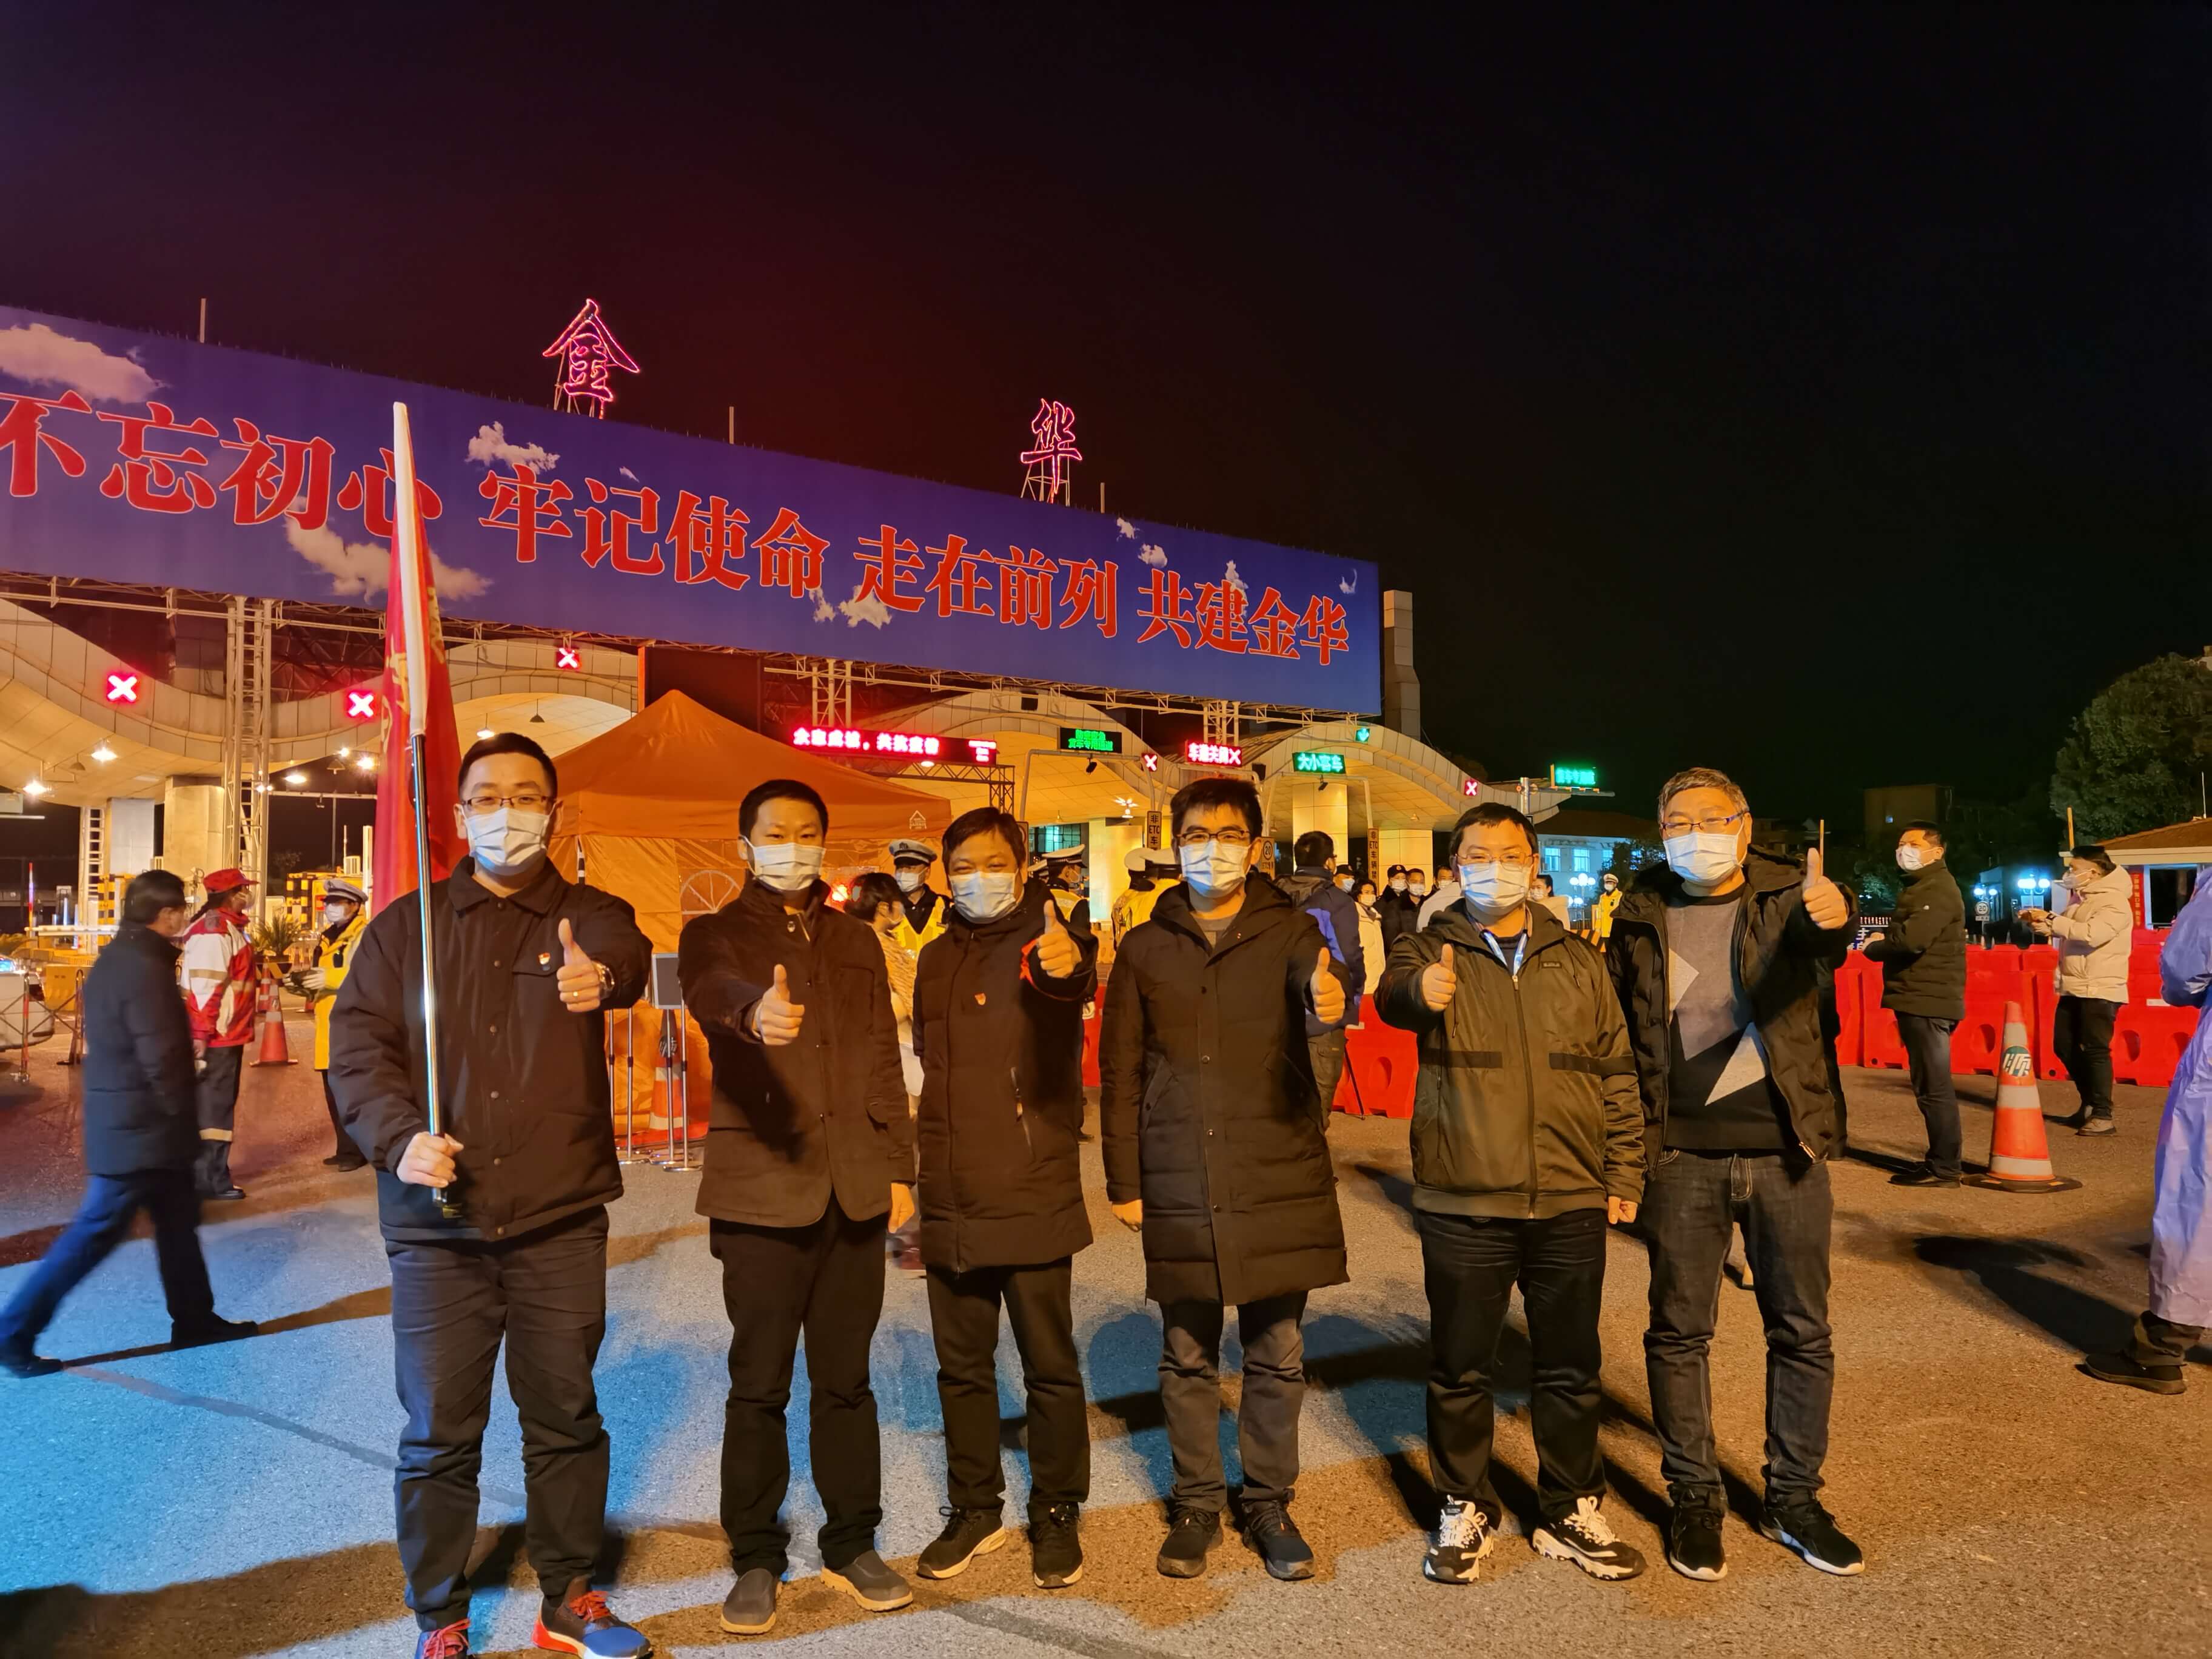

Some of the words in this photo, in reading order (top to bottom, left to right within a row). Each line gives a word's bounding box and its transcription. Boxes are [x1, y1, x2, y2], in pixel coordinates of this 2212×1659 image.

[543, 298, 640, 403] 金
[1020, 398, 1083, 495] 华
[0, 389, 443, 538] 不忘初心
[478, 463, 830, 599] 牢记使命
[853, 524, 1119, 638] 走在前列
[1137, 568, 1349, 666] 共建金华
[1298, 752, 1343, 773] 大小客车
